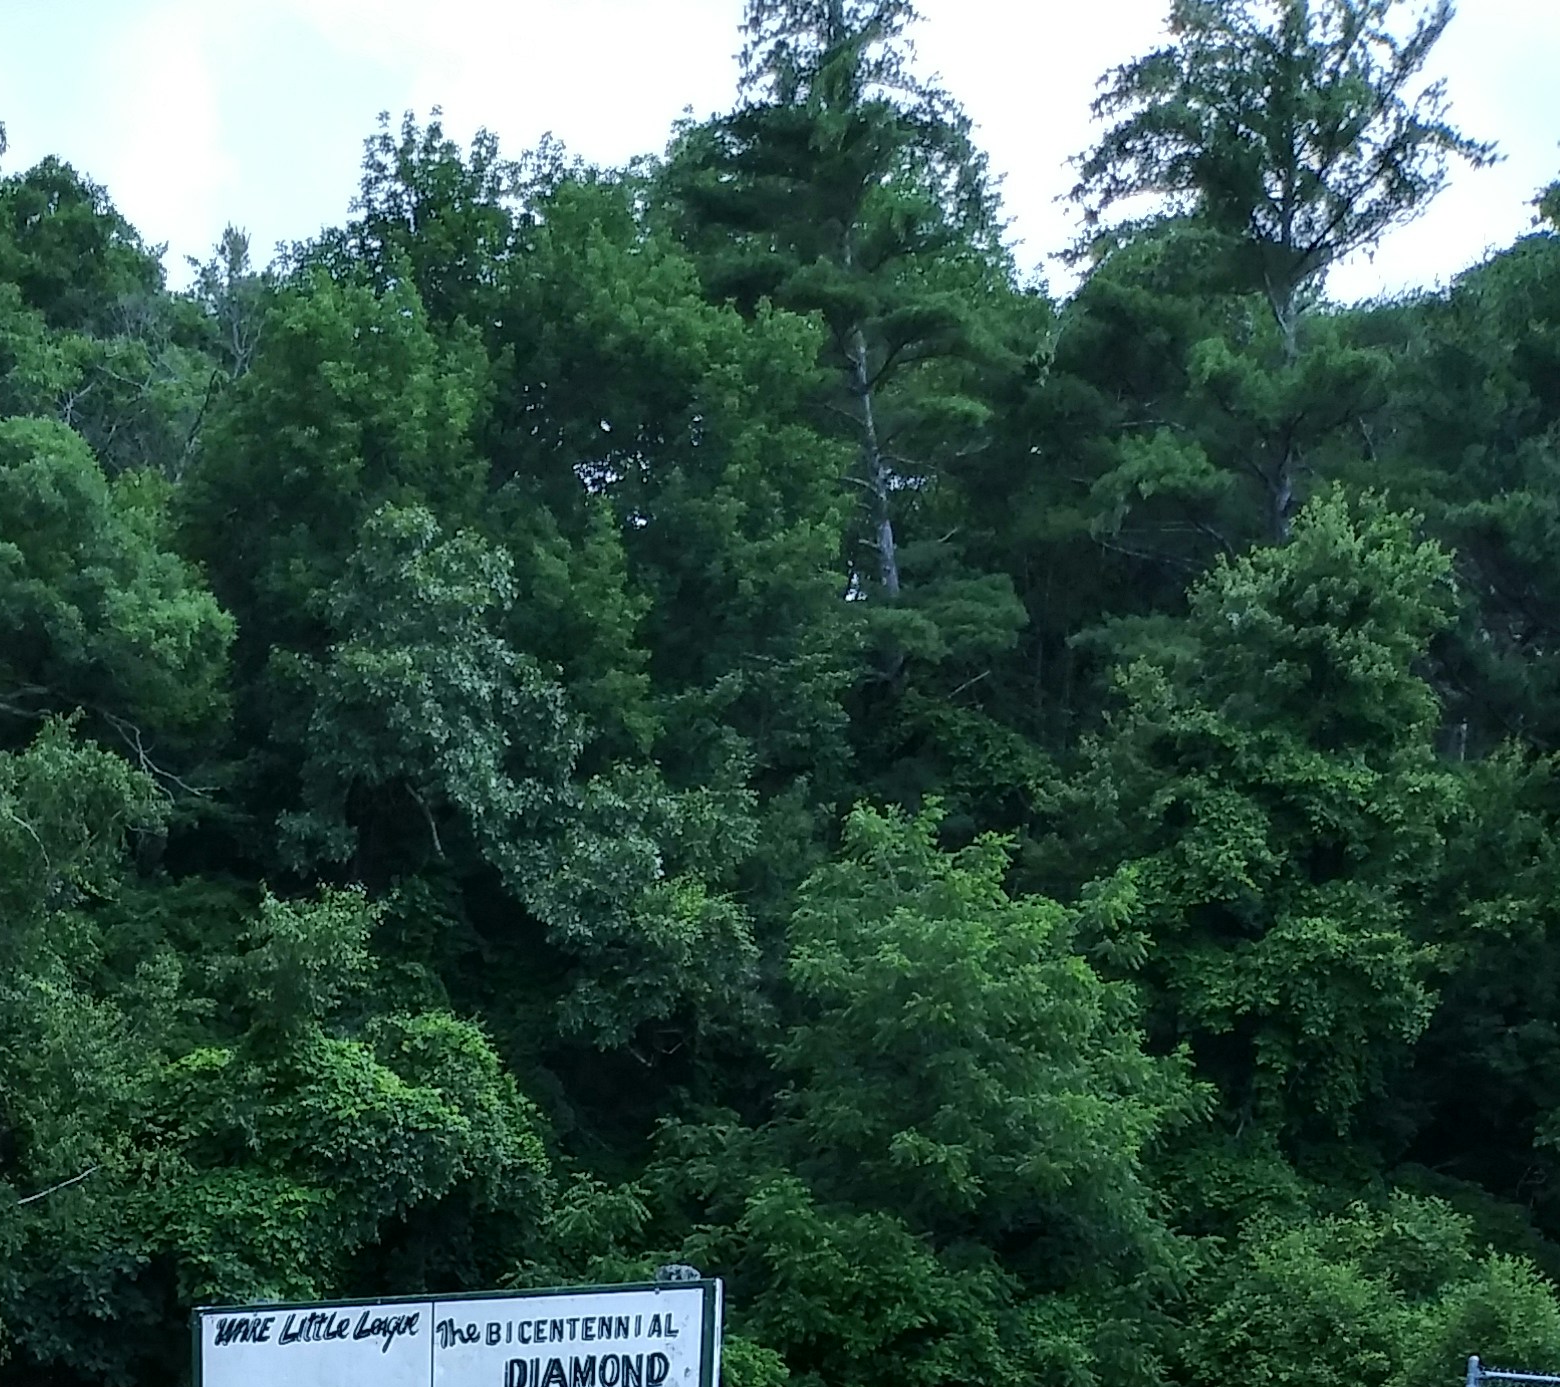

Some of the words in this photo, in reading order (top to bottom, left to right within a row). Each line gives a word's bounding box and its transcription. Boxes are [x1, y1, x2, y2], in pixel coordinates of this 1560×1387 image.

[352, 1310, 420, 1353] League
[436, 1318, 481, 1348] The
[486, 1313, 679, 1346] BICENTENNIAL
